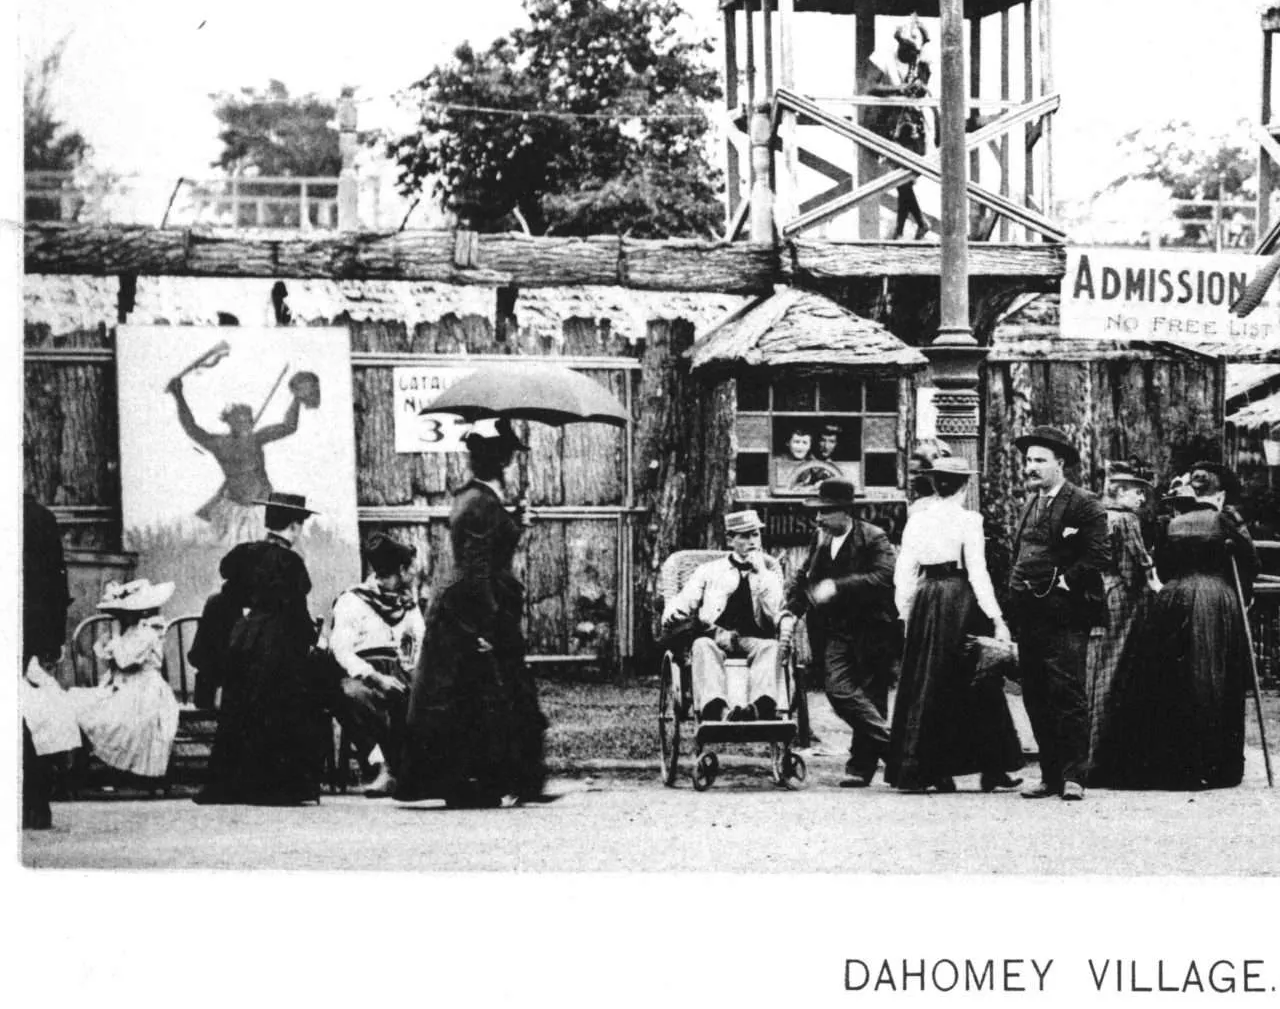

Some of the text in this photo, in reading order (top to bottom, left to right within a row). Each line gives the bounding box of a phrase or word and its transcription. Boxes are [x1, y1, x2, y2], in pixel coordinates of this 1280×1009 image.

[1072, 254, 1249, 308] ADMISSION
[1148, 317, 1218, 335] FREE
[1228, 319, 1273, 338] LIST
